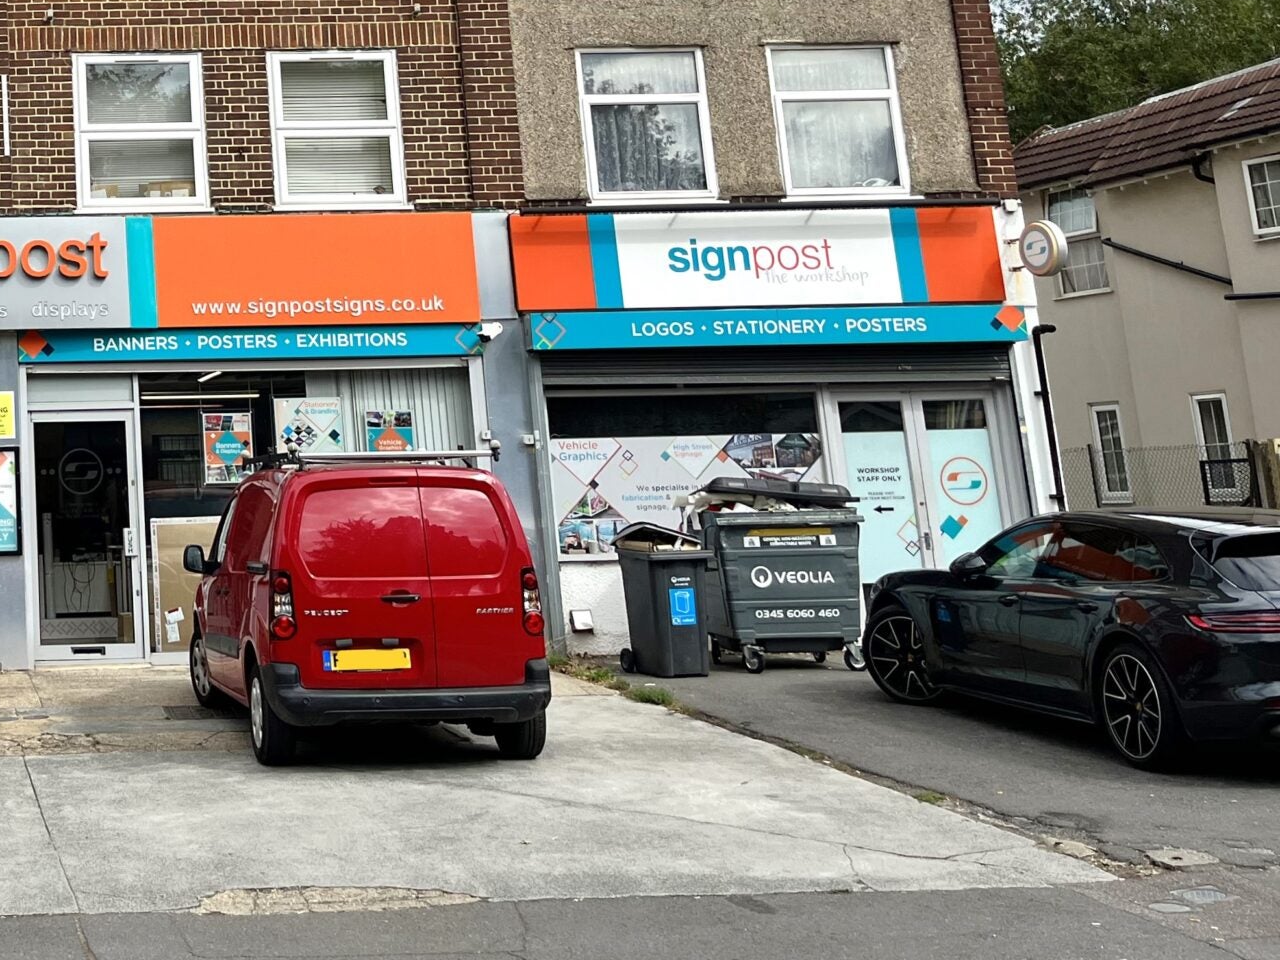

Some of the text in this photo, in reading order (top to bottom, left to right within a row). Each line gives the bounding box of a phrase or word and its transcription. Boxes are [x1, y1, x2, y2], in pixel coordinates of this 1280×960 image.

[668, 238, 834, 281] signpost
[765, 266, 869, 286] the workshop
[31, 300, 109, 320] displays
[192, 295, 444, 317] www.signpostsigns.co.uk
[631, 317, 927, 337] LOGOS STATIONERY POSTERS
[93, 332, 408, 352] BANNERS POSTERS EXHIBITIONS
[304, 401, 338, 410] Stationery
[558, 440, 598, 450] Vehicle
[673, 443, 690, 452] High
[559, 451, 608, 462] Graphics
[651, 484, 689, 492] specialise
[774, 571, 835, 584] VEOLIA
[755, 608, 840, 619] 0345 6060 460
